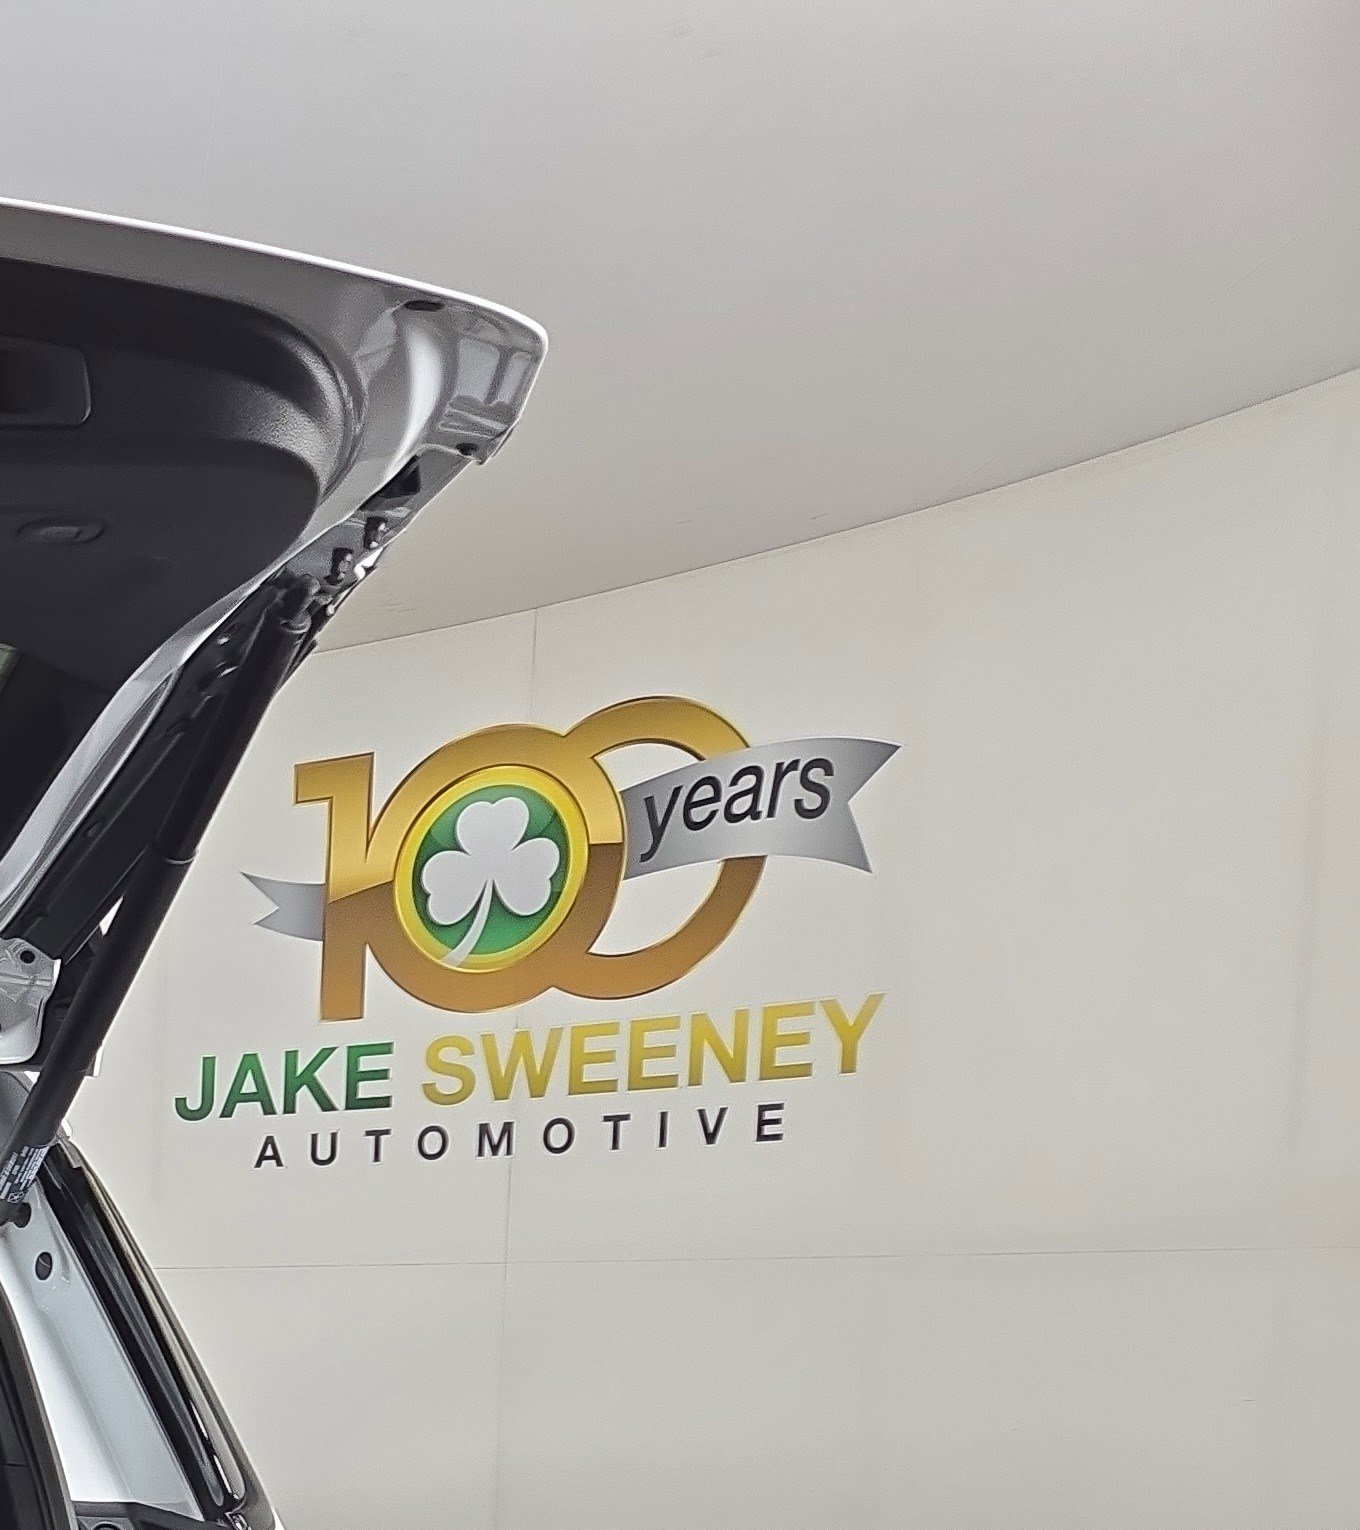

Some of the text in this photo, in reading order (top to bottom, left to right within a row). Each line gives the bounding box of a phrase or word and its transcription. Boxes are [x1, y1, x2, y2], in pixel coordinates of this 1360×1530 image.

[638, 755, 834, 863] years
[174, 992, 887, 1123] JAKE SWEENEY
[254, 1102, 787, 1170] AUTOMOTIVE
